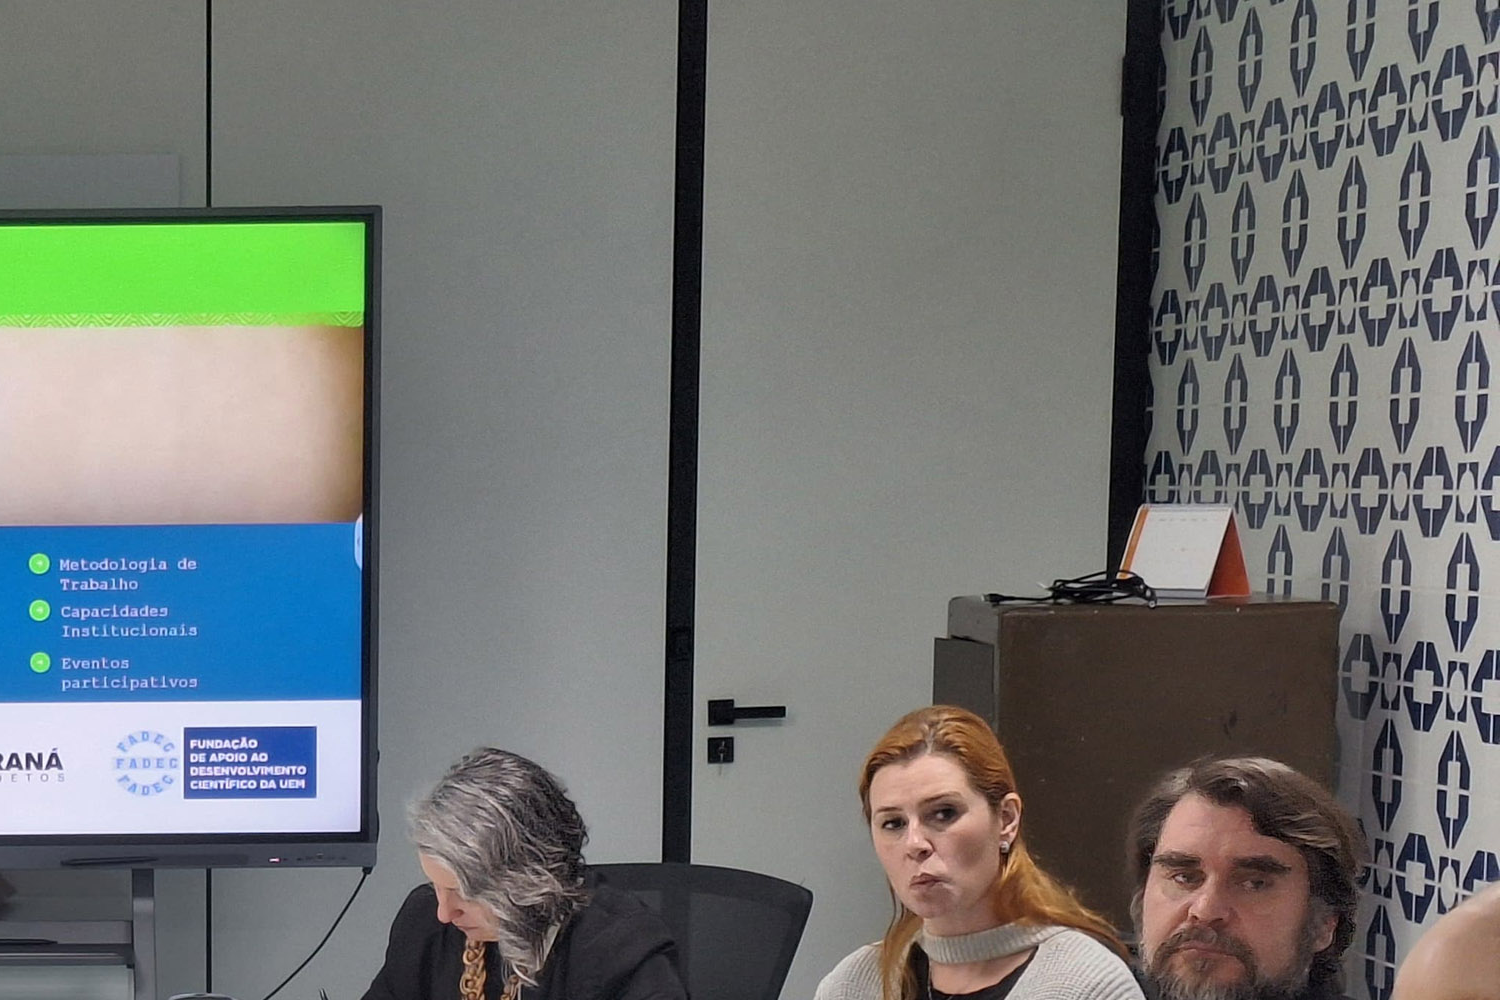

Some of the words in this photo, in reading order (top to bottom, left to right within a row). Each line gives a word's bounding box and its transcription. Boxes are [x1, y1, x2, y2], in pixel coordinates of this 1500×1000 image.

[59, 558, 167, 573] Metodologia
[177, 558, 197, 570] de
[60, 578, 139, 591] Trabalho
[61, 605, 168, 620] Capacidades
[61, 624, 198, 638] Institucionais
[61, 657, 130, 670] Eventos
[61, 676, 198, 692] participativos
[116, 730, 175, 753] FADEC
[190, 737, 258, 750] FUNDAÇÃO
[116, 758, 178, 769] FADEC
[190, 753, 206, 763] DE
[209, 753, 248, 763] APOIO
[251, 753, 269, 762] AO
[190, 766, 307, 776] DESENVOLVIMENTO
[190, 778, 257, 790] CIENTÍFICO
[260, 780, 277, 789] DA
[279, 779, 306, 789] UEM
